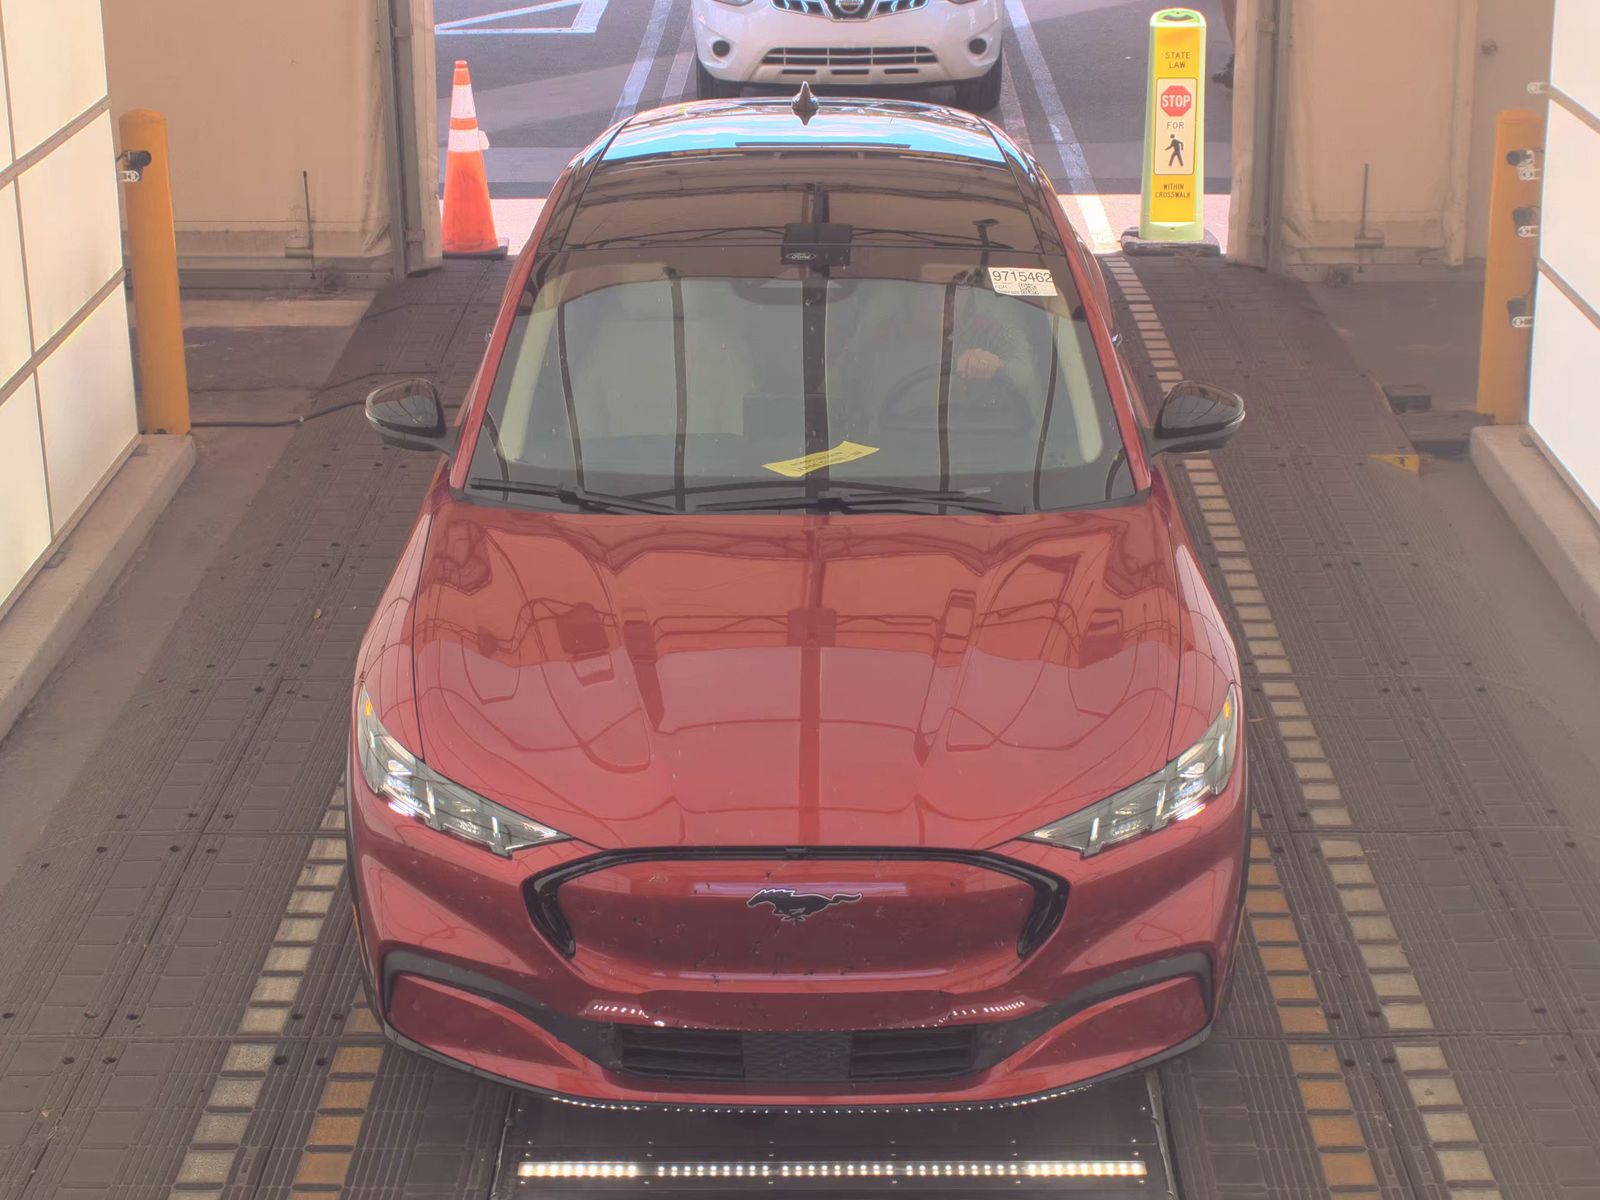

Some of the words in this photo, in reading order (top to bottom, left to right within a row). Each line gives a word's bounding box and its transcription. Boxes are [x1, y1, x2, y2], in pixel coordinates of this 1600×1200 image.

[1165, 51, 1190, 59] STATE
[1169, 61, 1185, 69] LAW
[1162, 95, 1190, 108] STOP
[1167, 121, 1184, 130] FOR
[1155, 191, 1191, 199] CROSSWALK
[992, 270, 1053, 283] 9715462
